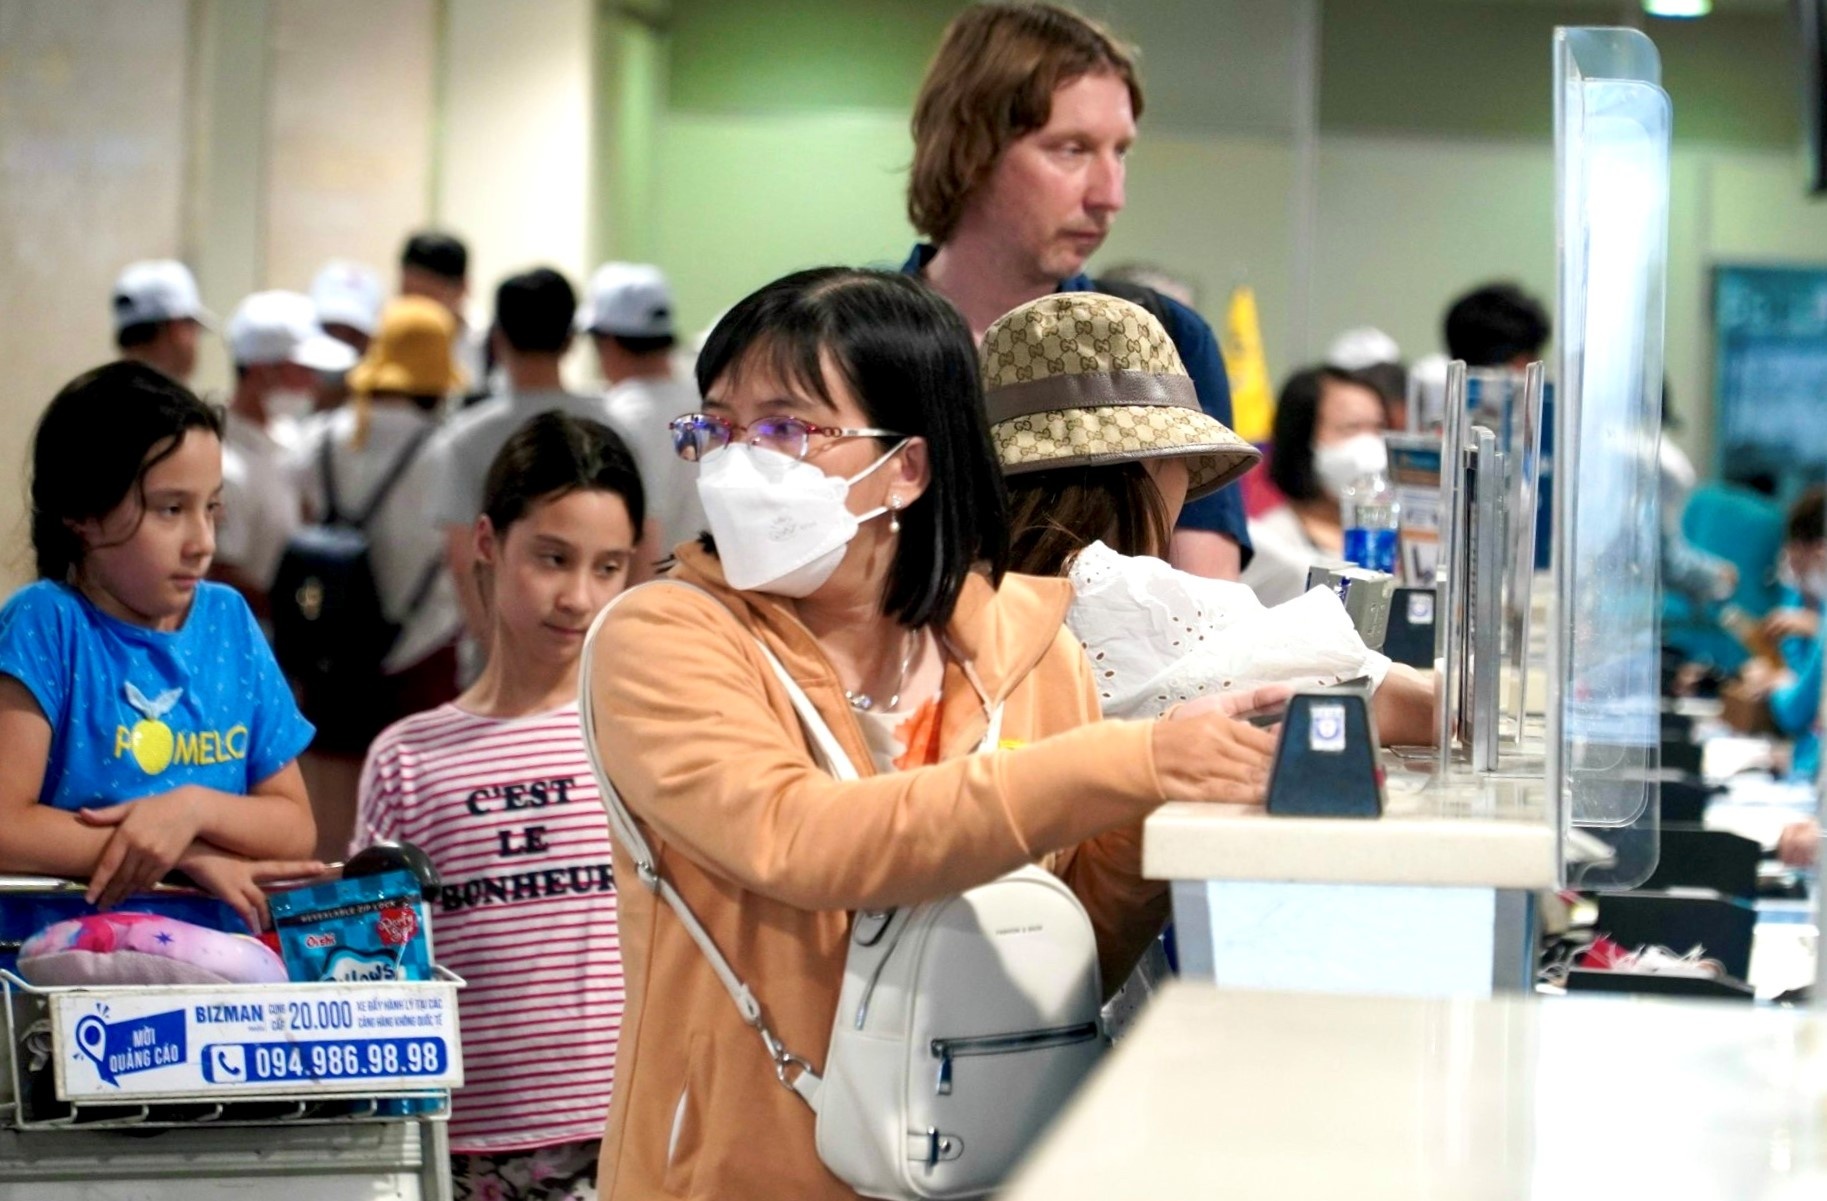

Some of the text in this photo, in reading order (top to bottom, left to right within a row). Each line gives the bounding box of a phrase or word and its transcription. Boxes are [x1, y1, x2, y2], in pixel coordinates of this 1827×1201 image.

[467, 778, 576, 816] C'EST
[498, 826, 548, 858] LE
[195, 1004, 264, 1024] BIZMAN
[288, 1000, 353, 1031] 20.000
[132, 1024, 156, 1048] MỜI
[109, 1041, 179, 1073] QUẢNG CÁO
[255, 1042, 439, 1078] 094.986.98.98
